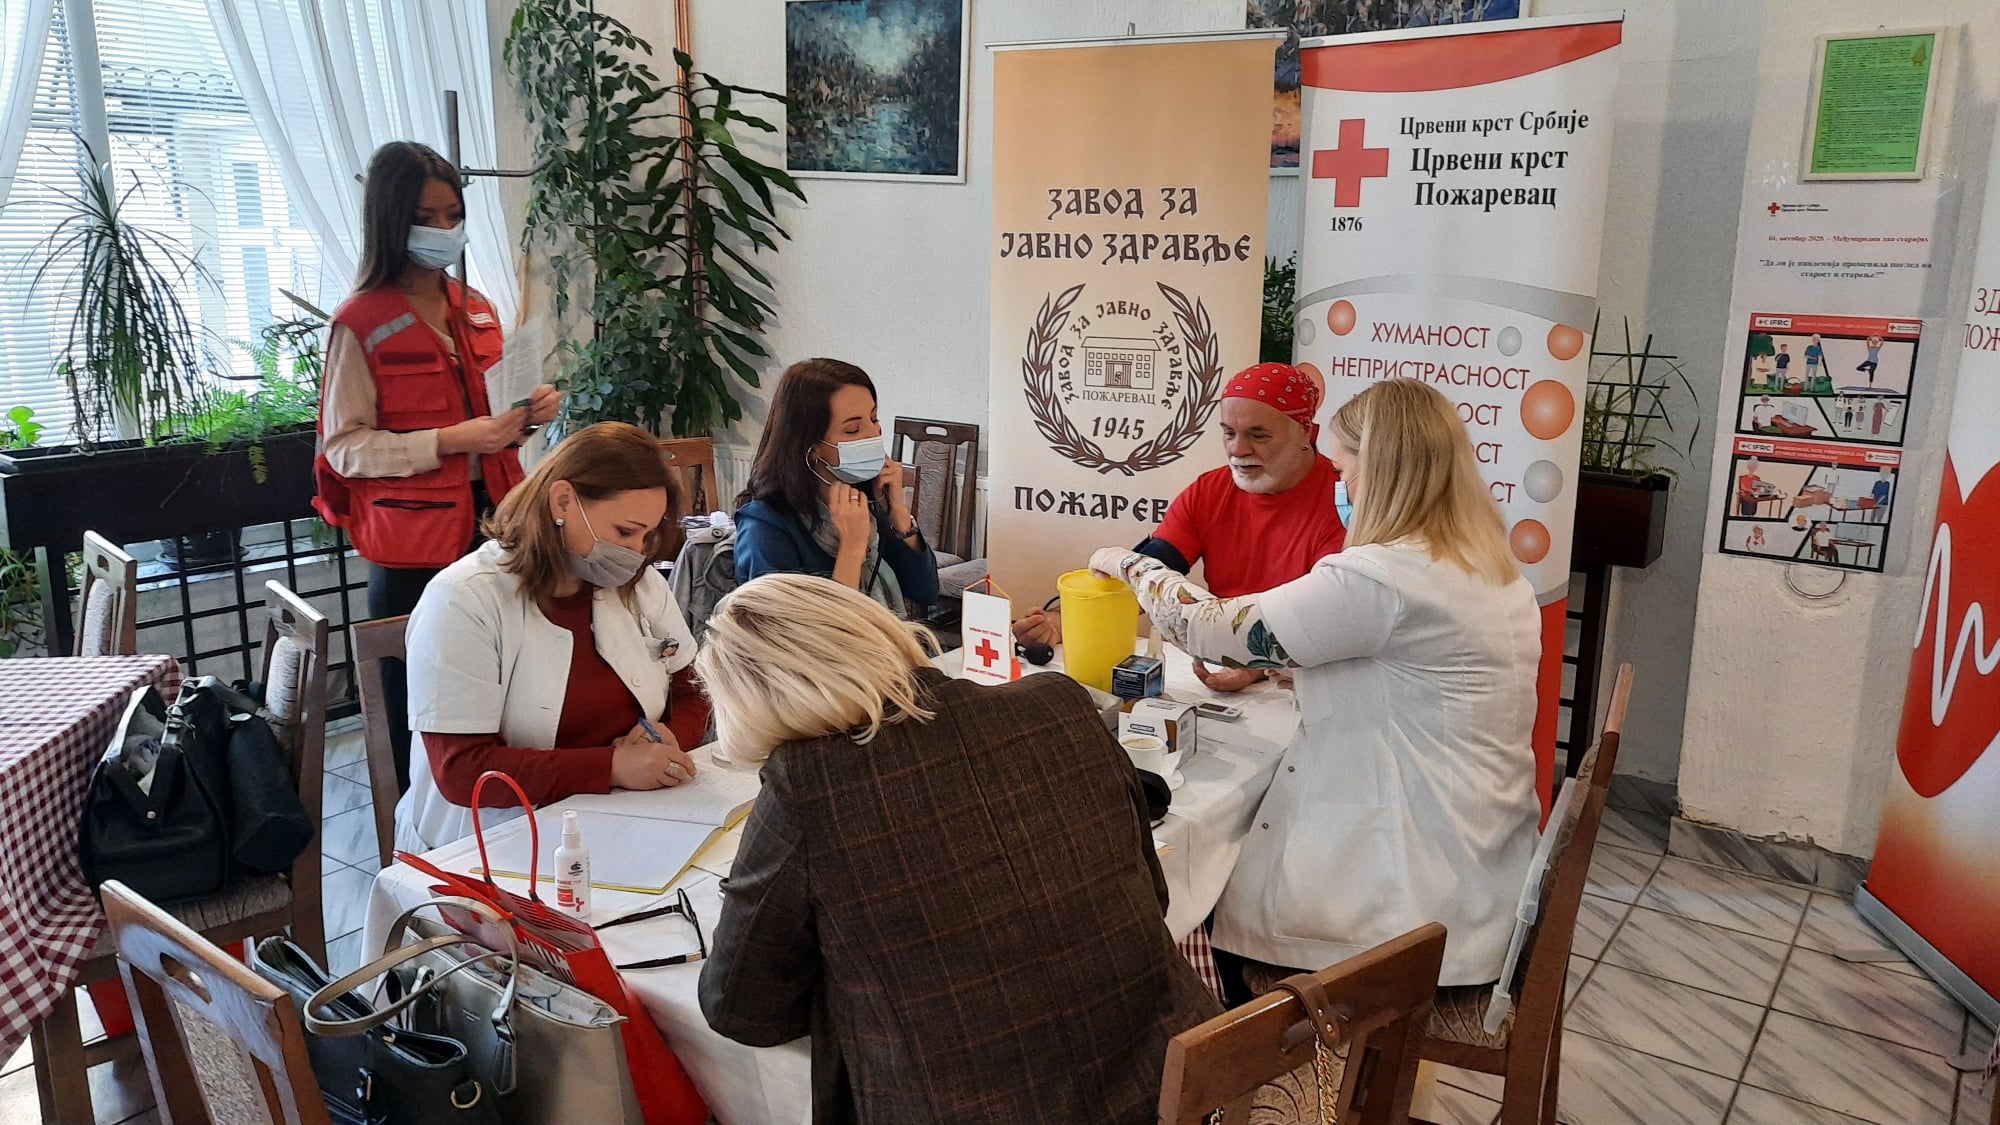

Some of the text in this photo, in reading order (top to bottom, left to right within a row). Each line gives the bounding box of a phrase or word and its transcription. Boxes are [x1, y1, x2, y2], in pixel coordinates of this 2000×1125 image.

[1400, 109, 1589, 139] Црвени крст Србије
[1410, 147, 1569, 178] Црвени крст
[1047, 187, 1197, 220] ЗАВОД ЗА
[1413, 182, 1558, 213] Пожаревац
[1330, 216, 1364, 232] 1876
[1000, 232, 1251, 266] ЈАВНО ЗДРАВЉЕ
[1371, 322, 1491, 349] ХУМАНОСТ
[1058, 345, 1080, 404] ЗАВОД
[1070, 315, 1091, 340] ЗА
[1096, 300, 1151, 321] ЈАВНО
[1331, 356, 1531, 390] НЕПРИСТРАСНОСТ
[1082, 390, 1156, 405] ПОЖАРЕВАЦ
[1091, 416, 1145, 440] 1945
